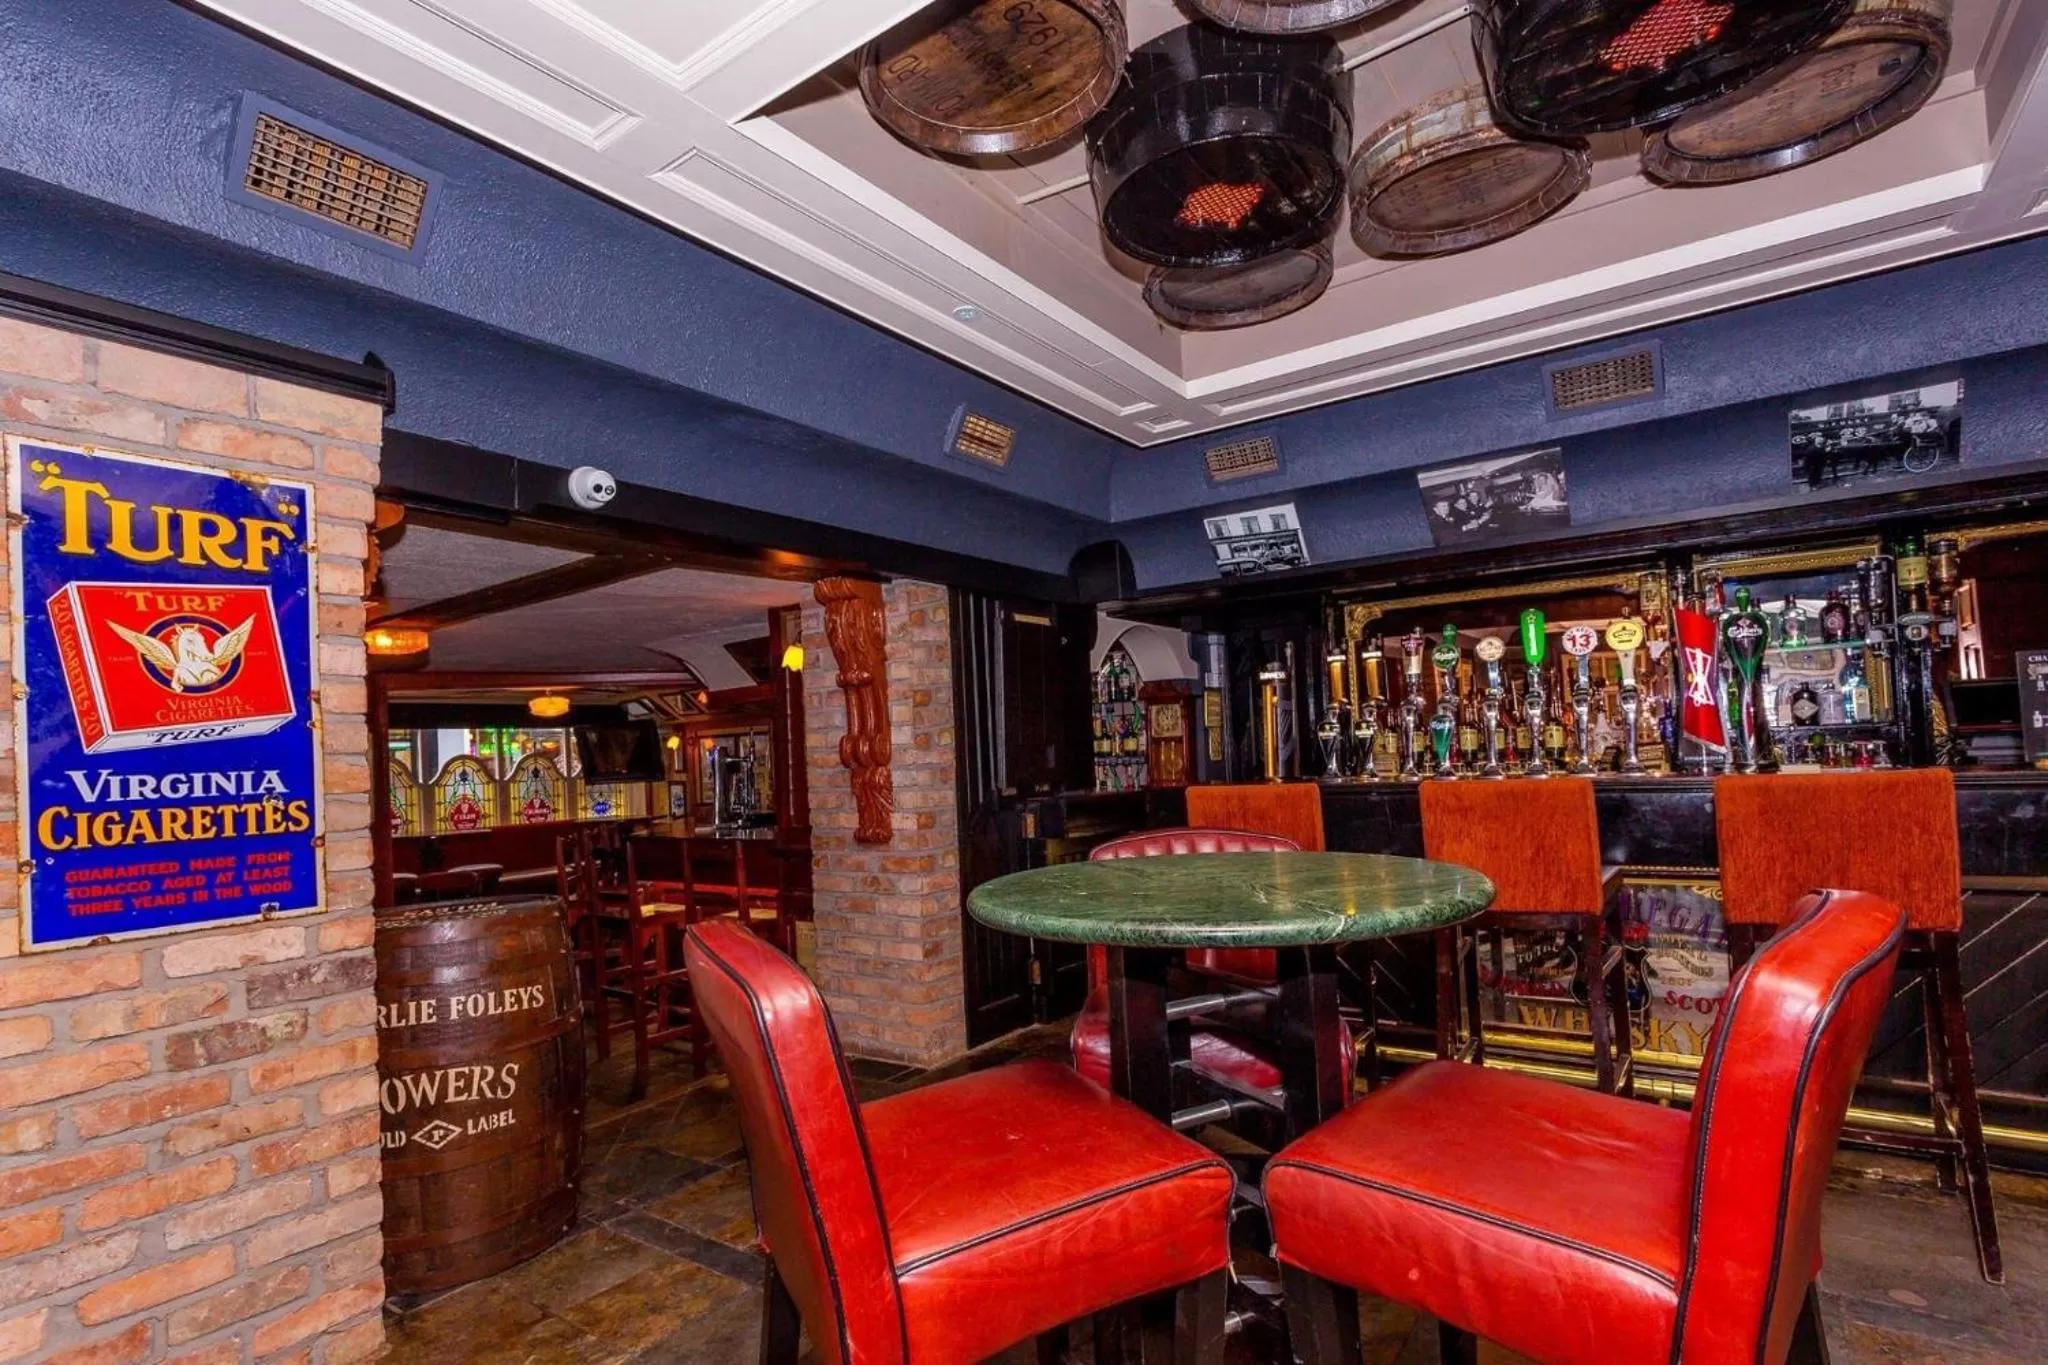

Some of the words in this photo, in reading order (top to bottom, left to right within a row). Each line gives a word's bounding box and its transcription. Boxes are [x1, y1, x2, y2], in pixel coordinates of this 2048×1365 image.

[53, 599, 70, 622] 20
[1567, 634, 1591, 649] 13
[61, 624, 90, 710] CIGARETTES
[156, 704, 254, 722] CIGARETTES
[166, 695, 242, 711] VIRGINIA
[84, 714, 100, 736] 20
[64, 769, 290, 803] VIRGINIA
[37, 800, 311, 851] CIGARETTES
[64, 862, 180, 883] GUARANTEED
[190, 856, 237, 871] MADE
[247, 851, 291, 865] FROM
[67, 880, 151, 899] TOBACCO
[162, 875, 206, 890] AGED
[215, 871, 234, 884] AT
[244, 866, 290, 882] LEAST
[68, 899, 124, 917] THREE
[132, 893, 186, 909] YEARS
[192, 891, 208, 903] IN
[214, 886, 242, 899] THE
[250, 881, 292, 895] WOOD
[449, 985, 545, 1020] FOLEYS
[1518, 1004, 1714, 1056] WHSKY
[380, 1062, 520, 1115] OWERS
[467, 1109, 516, 1135] LABEL
